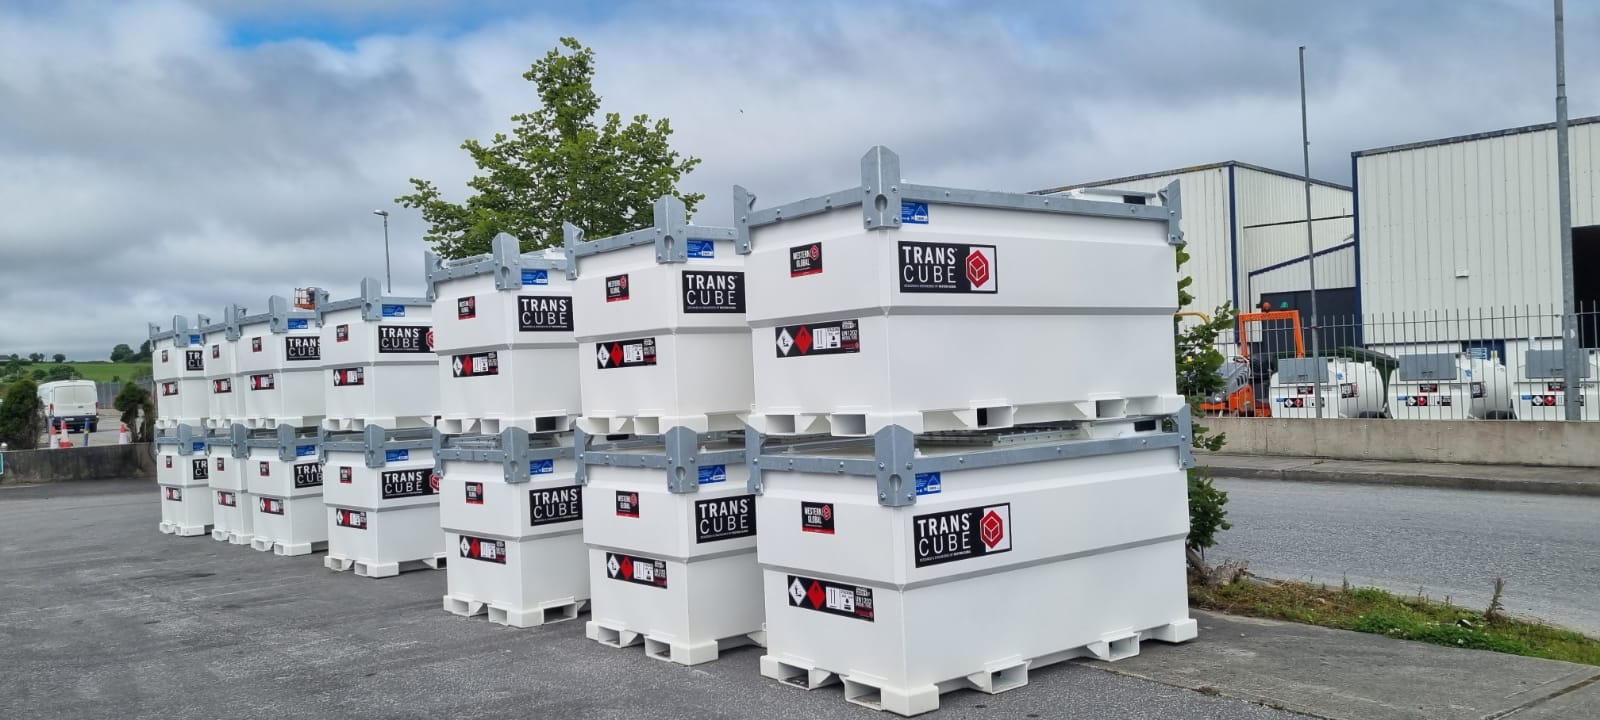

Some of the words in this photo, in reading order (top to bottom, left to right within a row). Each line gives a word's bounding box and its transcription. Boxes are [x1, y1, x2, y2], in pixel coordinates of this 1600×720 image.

[902, 246, 956, 265] TRANS
[686, 274, 736, 290] TRANS
[903, 265, 956, 283] CUBE
[521, 298, 567, 312] TRANS
[686, 290, 737, 305] CUBE
[522, 311, 568, 325] CUBE
[381, 328, 419, 338] TRANS
[381, 337, 419, 348] CUBE
[384, 471, 423, 484] TRANS
[385, 481, 423, 494] CUBE
[533, 488, 578, 506] TRANS
[533, 501, 578, 519] CUBE
[699, 499, 748, 519] TRANS
[700, 514, 749, 535] CUBE
[917, 513, 970, 538] TRANS
[919, 531, 971, 557] CUBE
